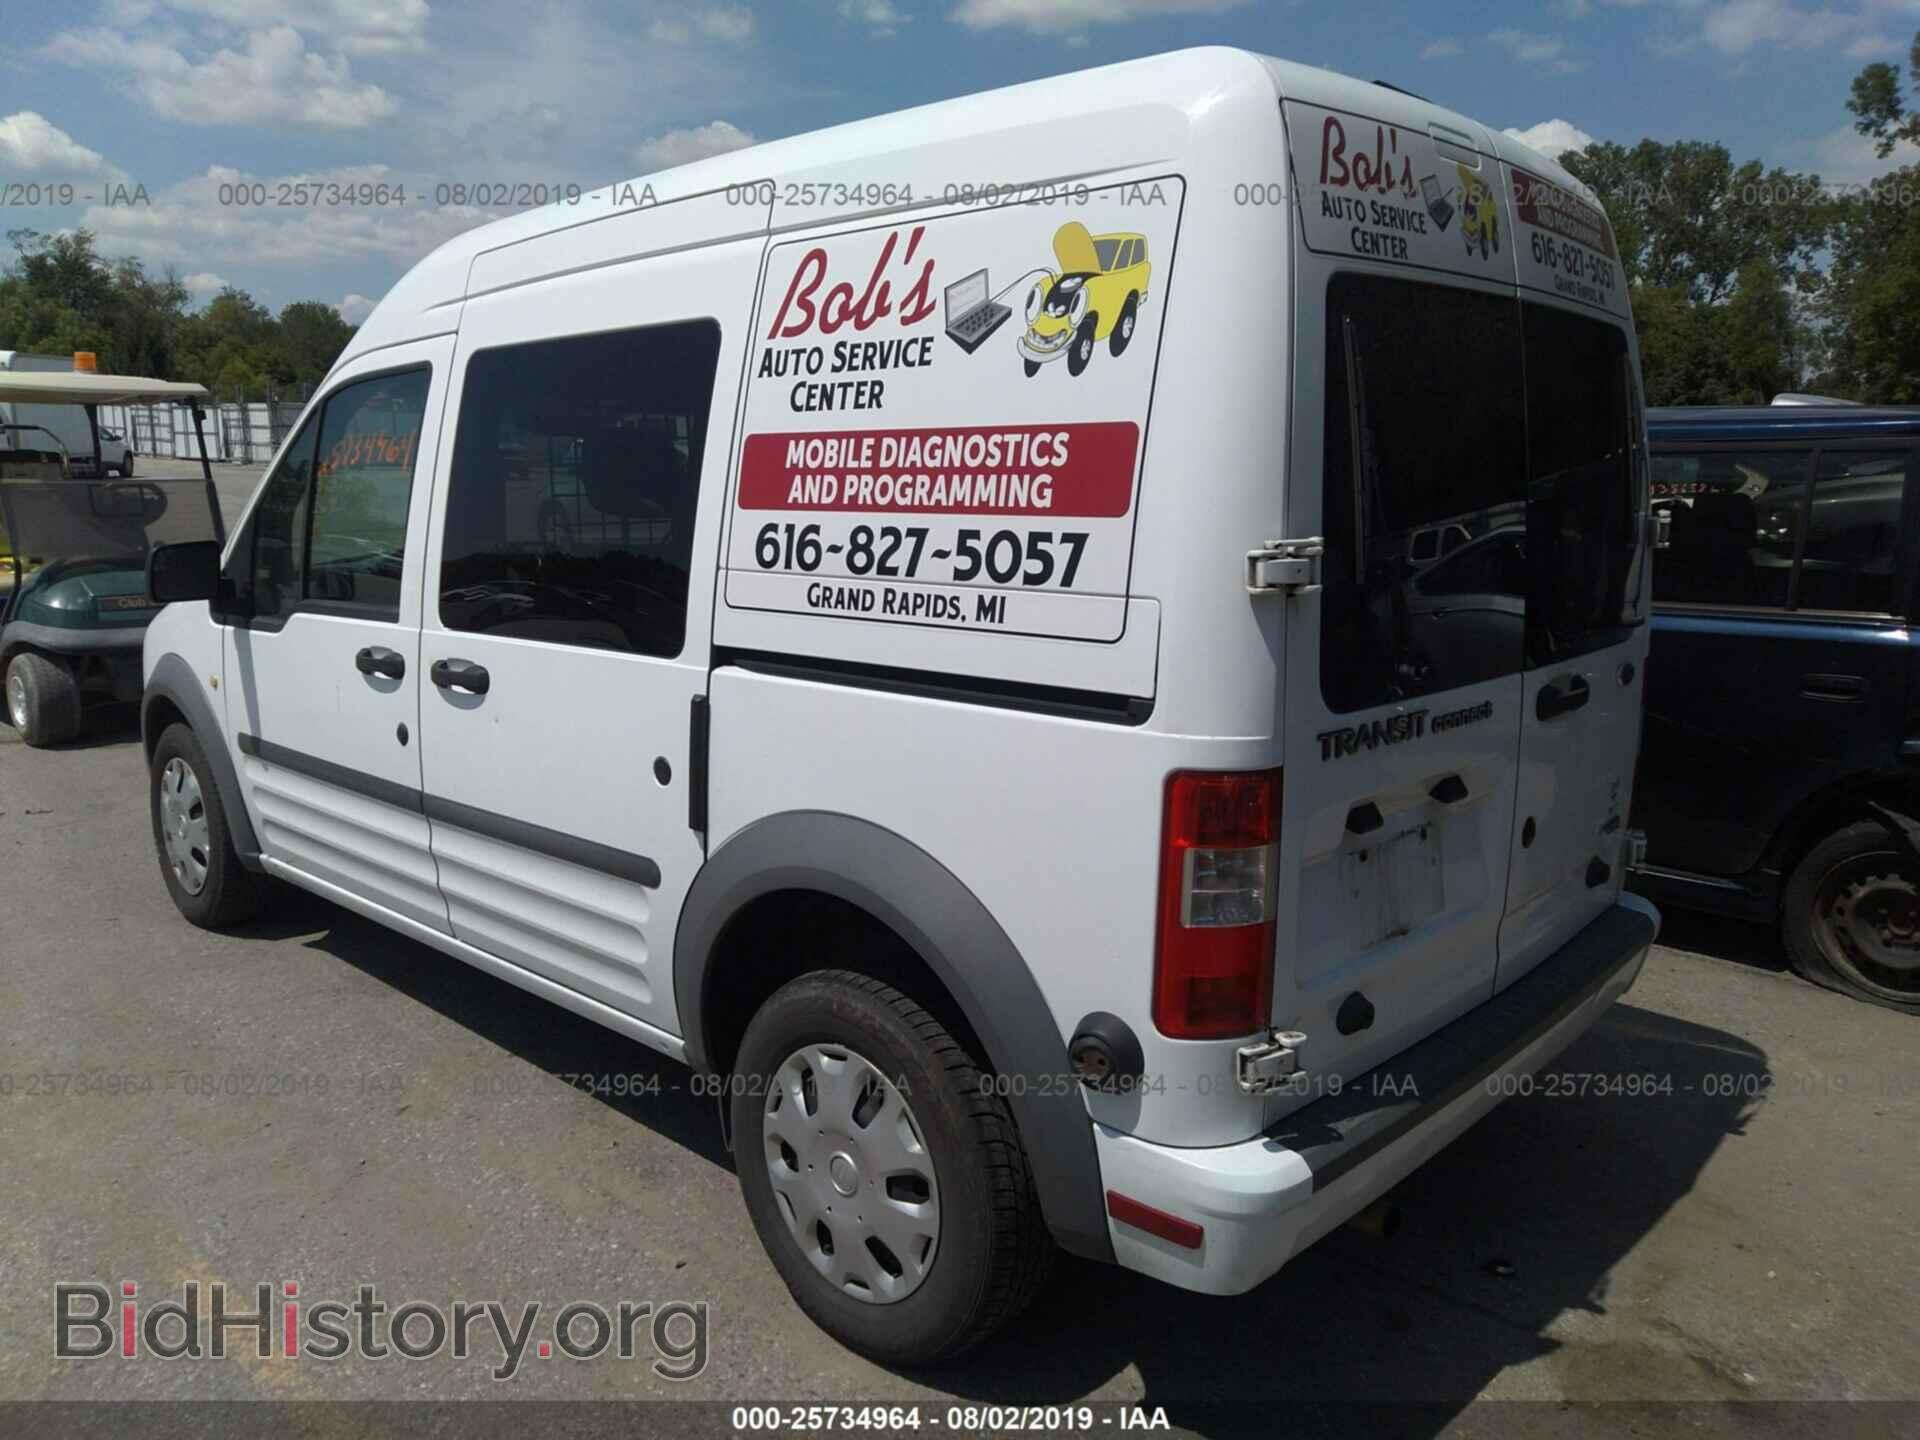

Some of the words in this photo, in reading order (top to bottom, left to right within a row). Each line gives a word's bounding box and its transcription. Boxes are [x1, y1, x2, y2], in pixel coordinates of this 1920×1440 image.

[1319, 115, 1418, 198] Bob's
[1321, 190, 1366, 223] AUTO
[1372, 199, 1428, 234] SERVICE
[1351, 226, 1408, 260] CENTER
[767, 226, 937, 340] Bob's
[757, 347, 824, 378] AUTO
[830, 336, 935, 373] SERVICE
[790, 379, 884, 413] CENTER
[785, 438, 875, 469] MOBILE
[879, 432, 1070, 468] DIAGNOSTICS
[787, 474, 838, 504] AND
[842, 473, 1053, 509] PROGRAMMING
[807, 582, 875, 612] GRAND
[975, 594, 1007, 624] MI
[1316, 709, 1431, 762] TRANSIT
